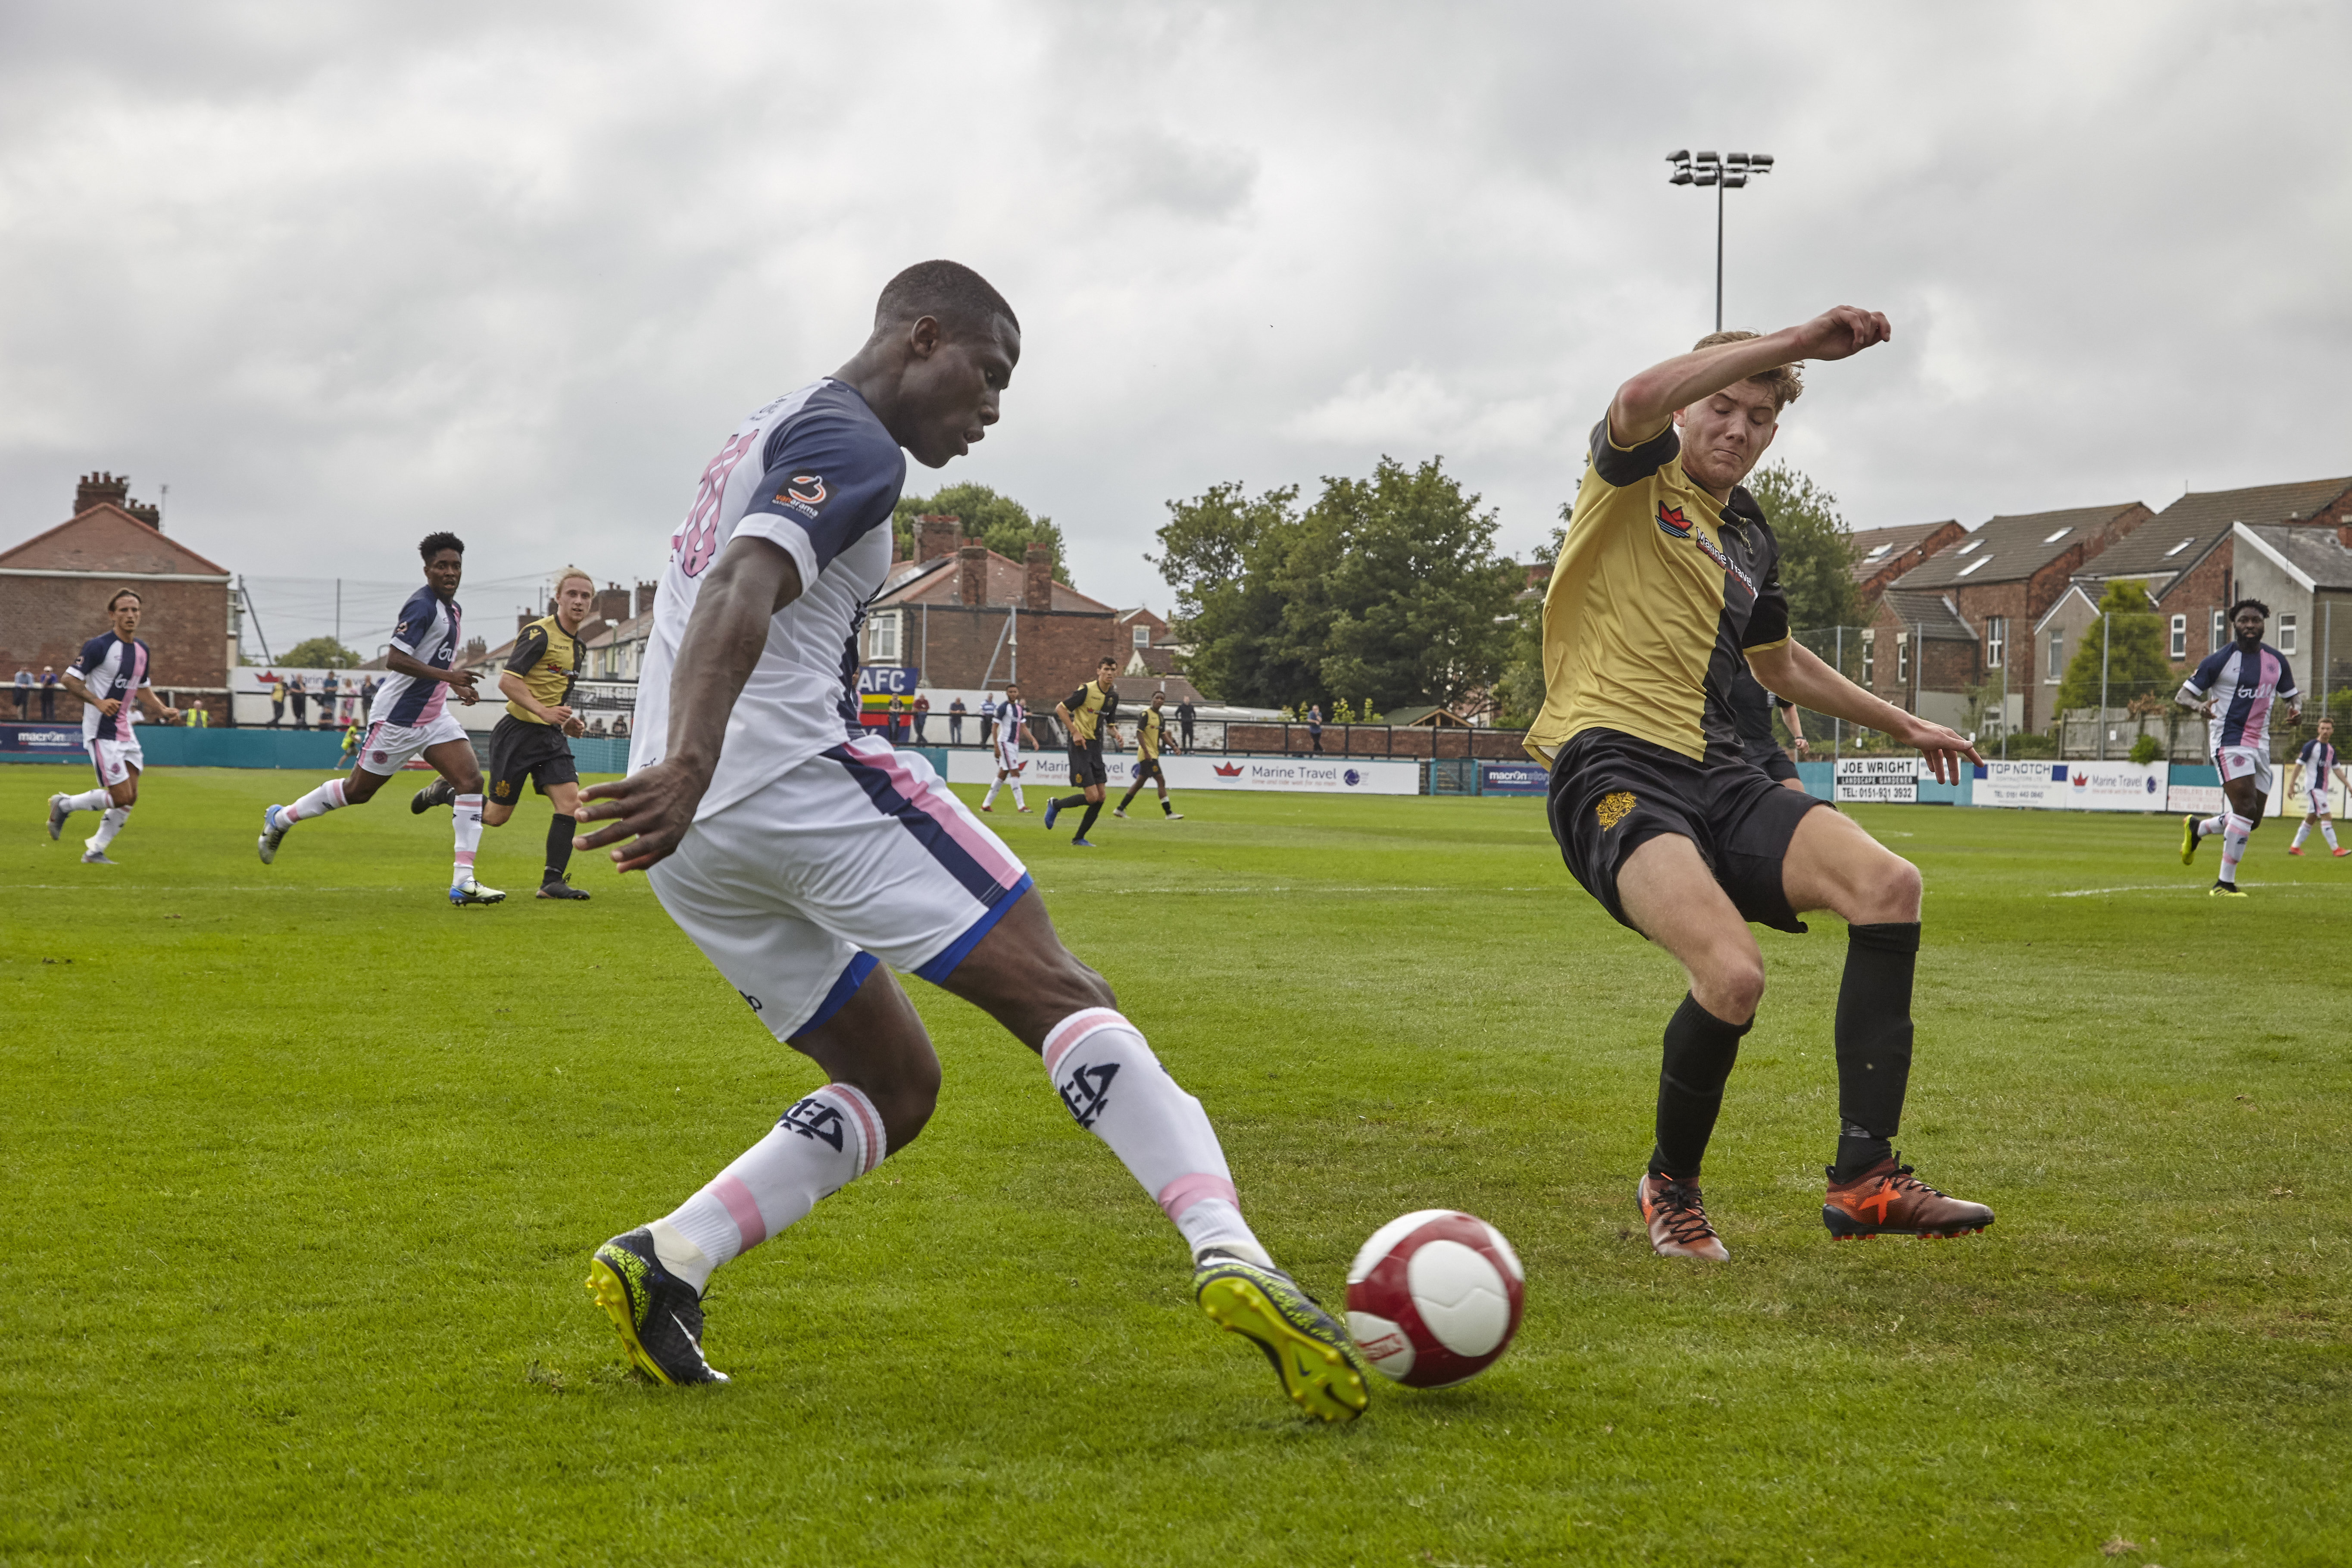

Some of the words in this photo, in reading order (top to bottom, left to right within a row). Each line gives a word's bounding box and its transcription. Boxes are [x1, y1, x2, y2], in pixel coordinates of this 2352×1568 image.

[775, 494, 819, 517] vanarama
[1696, 526, 1727, 565] Marine
[1727, 556, 1753, 590] Travel
[856, 669, 906, 692] AFC
[596, 686, 614, 699] THE
[18, 731, 65, 742] macron
[1036, 759, 1070, 772] Marin
[1104, 762, 1124, 773] vel
[1252, 765, 1294, 778] Marine
[1298, 766, 1337, 779] Travel
[1843, 762, 1863, 773] JOE
[1867, 761, 1912, 773] WRIGHT
[1990, 763, 2011, 774] TOP
[2013, 764, 2051, 774] NOTCH
[1489, 770, 1528, 780] macron
[1842, 776, 1876, 784] LANDSCAPE
[1878, 776, 1913, 784] GARDENER
[2093, 775, 2117, 787] Marine
[2118, 775, 2143, 787] Travel
[1842, 787, 1858, 797] TEL:
[1894, 787, 1912, 798] 3932
[1603, 812, 1624, 832] MARINE
